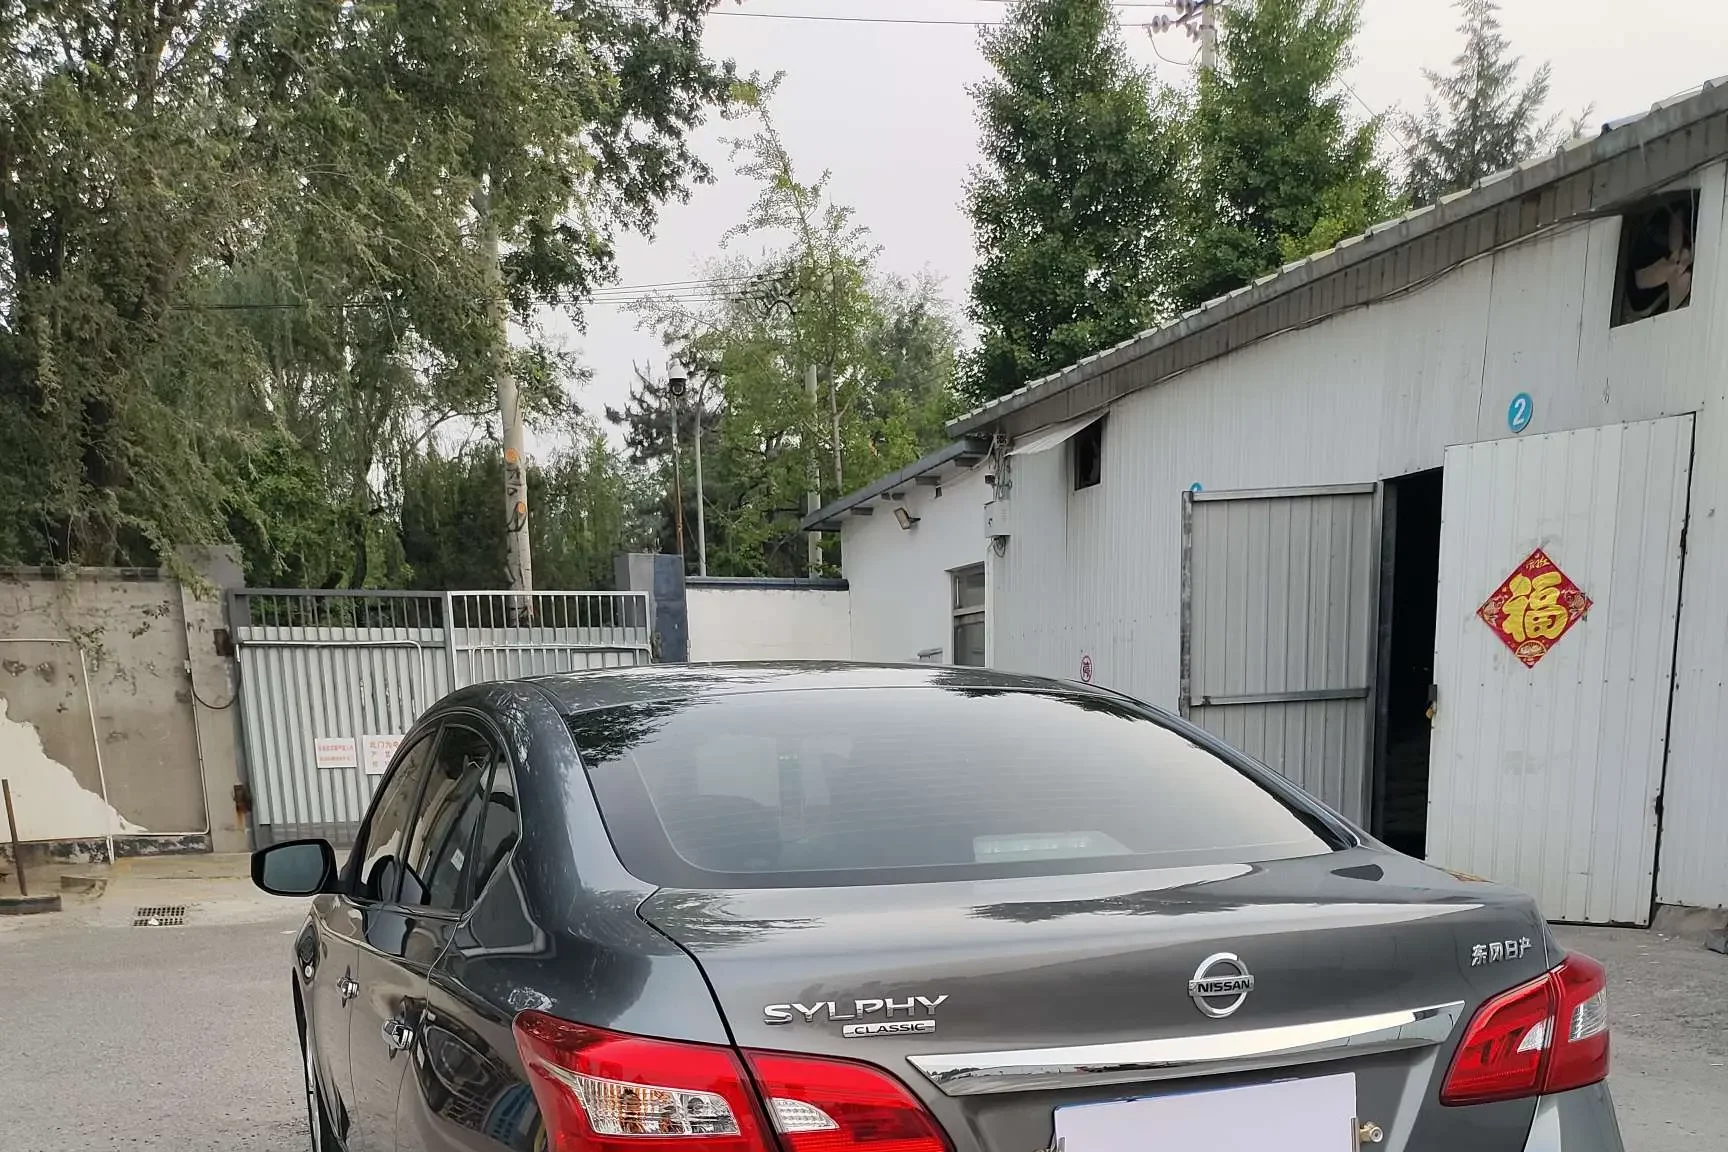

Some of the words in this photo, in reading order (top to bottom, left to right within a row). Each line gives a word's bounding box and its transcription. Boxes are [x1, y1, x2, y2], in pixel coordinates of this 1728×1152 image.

[1512, 398, 1526, 426] 2
[1501, 571, 1568, 642] 福
[1471, 936, 1532, 966] 东风日产
[1197, 979, 1250, 993] NISSAN
[764, 994, 949, 1026] SYLPHY
[854, 1022, 926, 1035] CLASSIC
